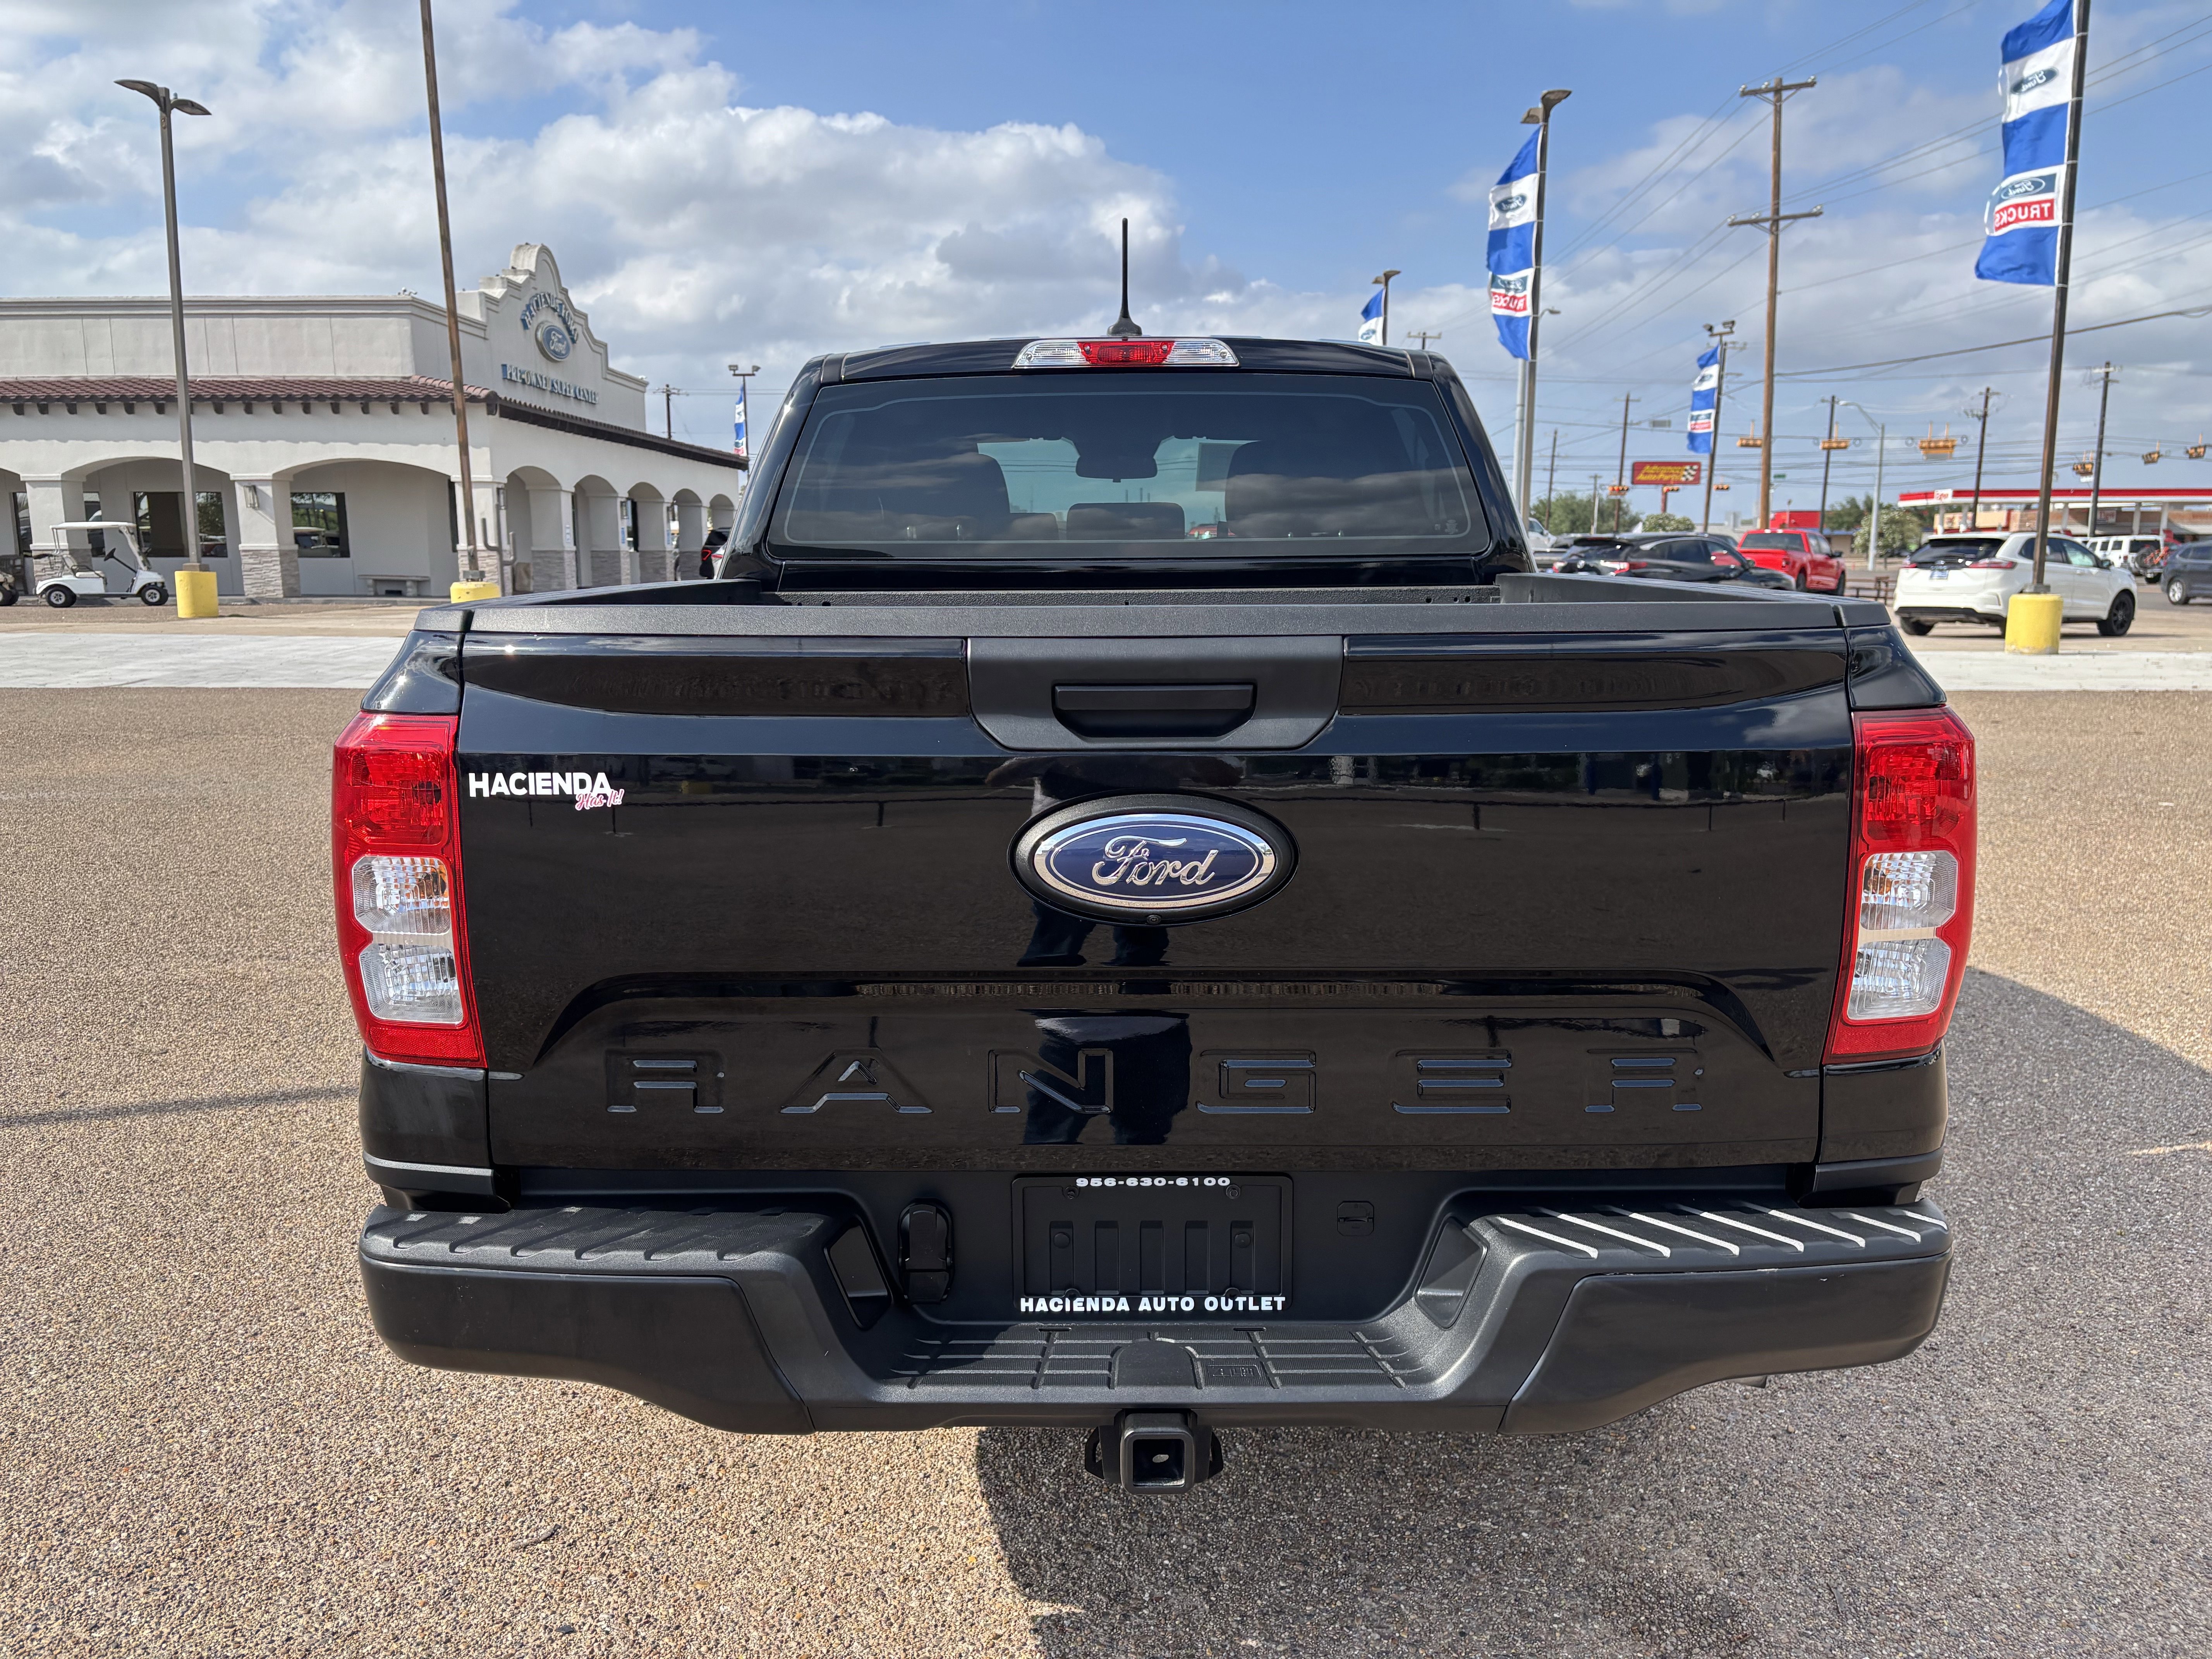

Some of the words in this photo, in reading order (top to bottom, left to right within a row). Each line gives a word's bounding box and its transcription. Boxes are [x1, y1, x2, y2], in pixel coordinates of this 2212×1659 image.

[550, 331, 567, 354] Ford
[552, 378, 575, 398] SUPER
[575, 386, 599, 404] CENTER
[469, 772, 612, 797] HACIENDA
[575, 792, 606, 811] Has
[606, 789, 625, 807] It!
[1092, 835, 1219, 886] Ford
[606, 1048, 1704, 1114] RANGER
[1076, 1177, 1231, 1187] 956-630-6100
[1020, 1297, 1130, 1312] HACIENDA
[1139, 1297, 1195, 1311] AUTO
[1204, 1297, 1286, 1311] OUTLET
